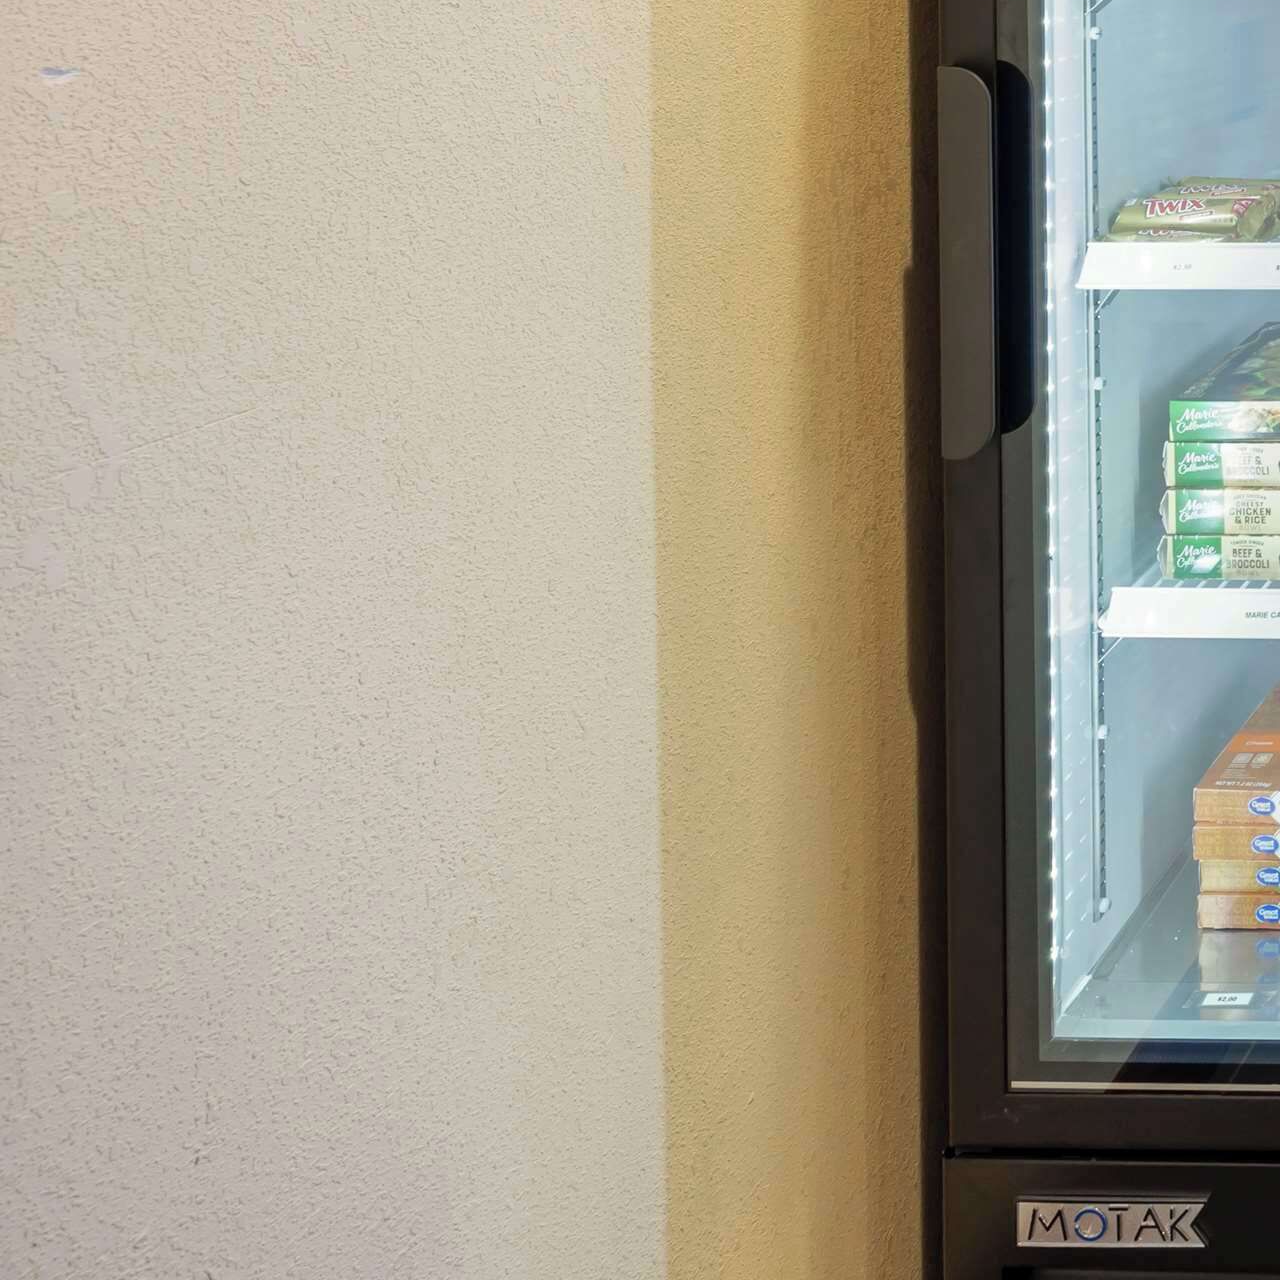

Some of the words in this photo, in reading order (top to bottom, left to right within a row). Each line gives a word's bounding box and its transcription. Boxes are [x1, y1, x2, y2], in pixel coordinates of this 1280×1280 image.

[1176, 408, 1219, 422] Marie
[1180, 452, 1216, 464] Marie
[1229, 508, 1272, 516] CHICKEN
[1244, 516, 1267, 524] RICE
[1177, 544, 1216, 558] Marie
[1232, 548, 1252, 558] BEEF
[1255, 548, 1262, 558] &
[1226, 560, 1270, 569] BROCCOLI
[1028, 1204, 1190, 1242] MOTAK
